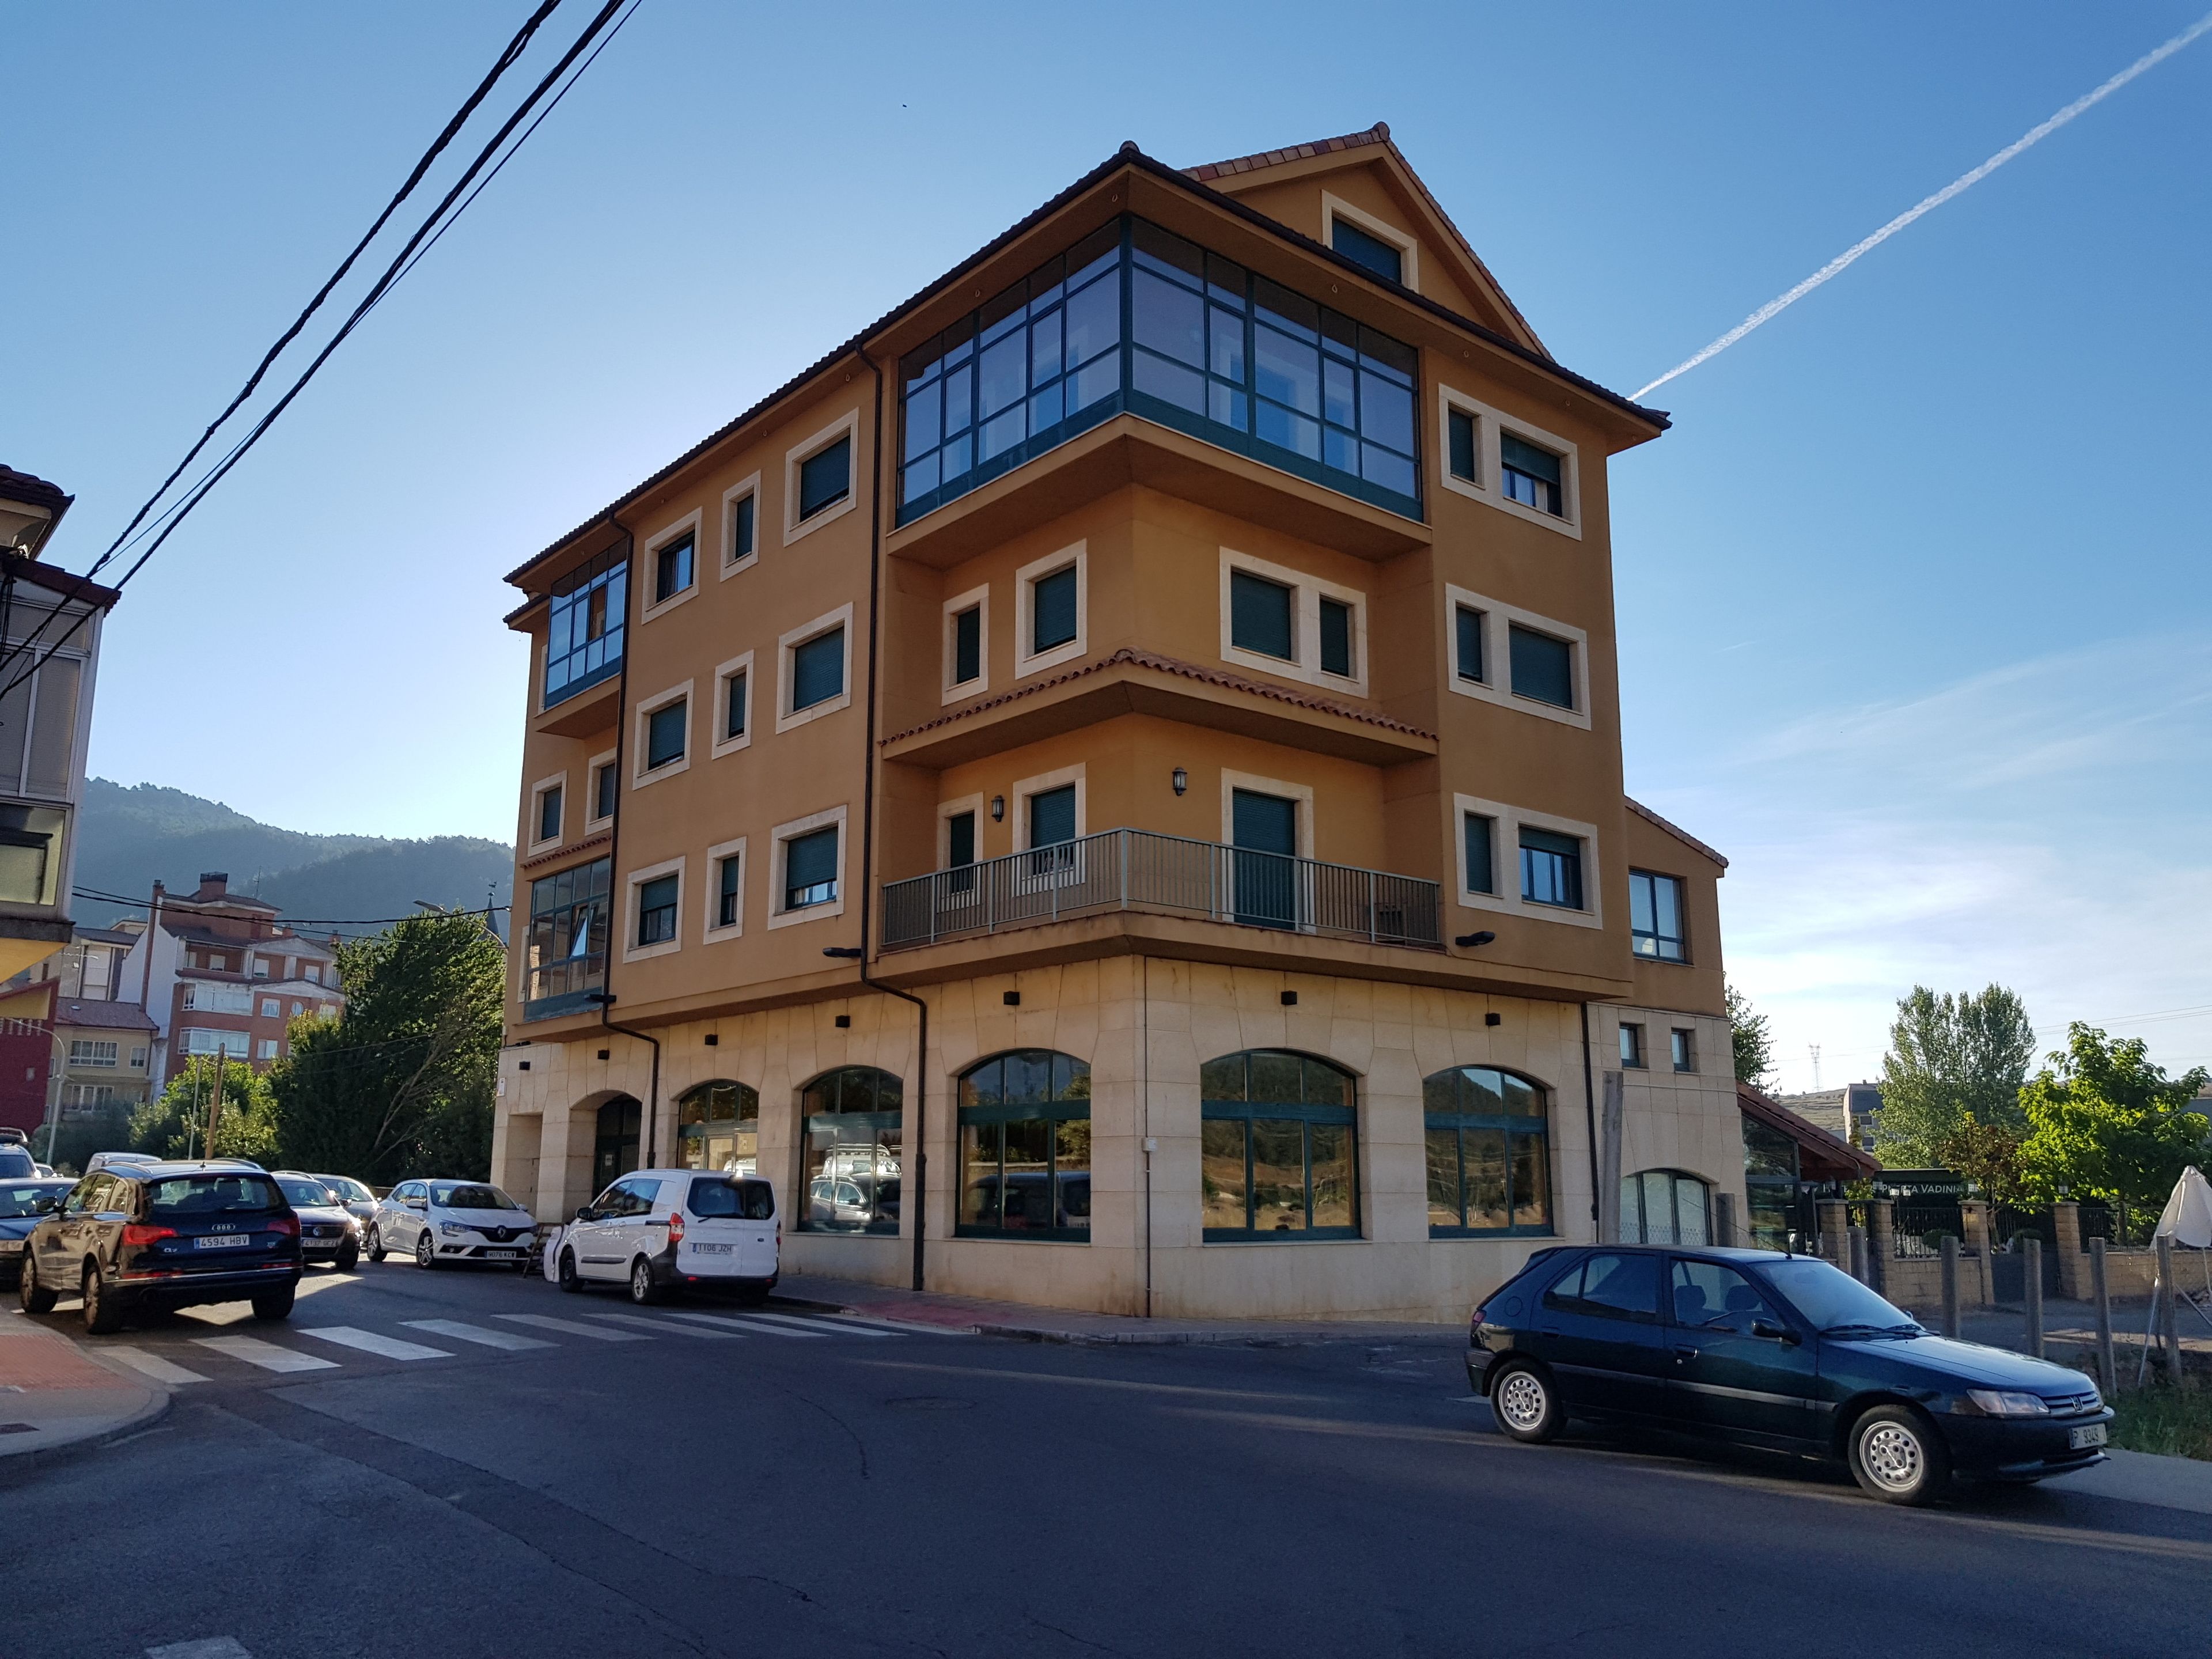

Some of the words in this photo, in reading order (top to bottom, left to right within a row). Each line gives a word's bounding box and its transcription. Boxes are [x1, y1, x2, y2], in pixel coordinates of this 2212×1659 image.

[1883, 1184, 1918, 1193] PRTA
[201, 1238, 225, 1247] 4594
[230, 1236, 247, 1245] HBV
[719, 1244, 732, 1252] JZH
